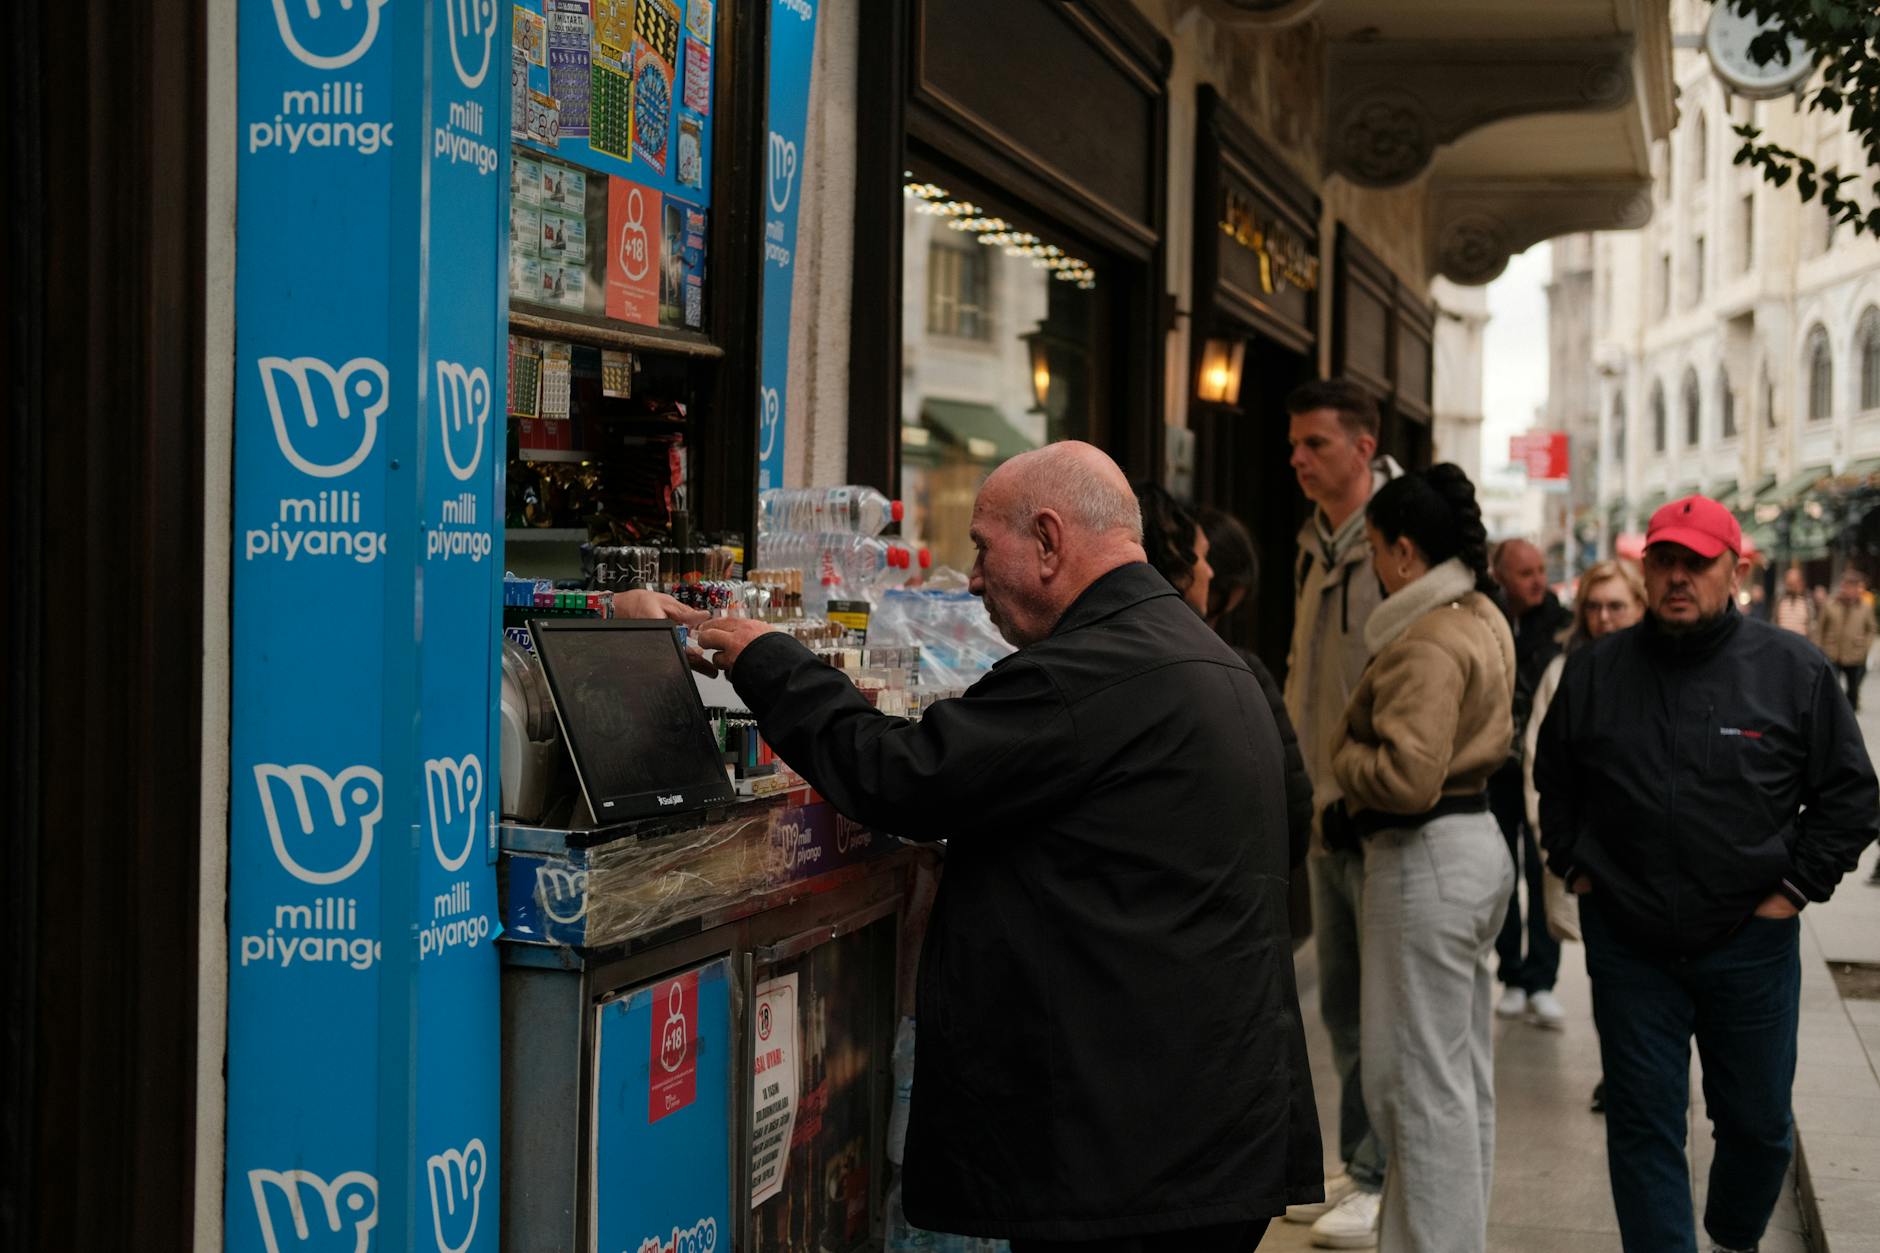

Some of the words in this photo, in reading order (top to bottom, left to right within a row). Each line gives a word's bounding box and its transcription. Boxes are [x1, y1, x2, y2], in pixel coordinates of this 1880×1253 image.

[283, 82, 363, 115] milli
[450, 101, 483, 136] milli
[435, 124, 498, 175] piyango
[625, 239, 643, 262] +18
[280, 490, 360, 523] milli
[442, 493, 476, 524] milli
[427, 523, 491, 562] piyango
[798, 828, 812, 845] milli
[797, 846, 822, 865] piyango
[275, 897, 356, 930] milli
[435, 881, 470, 919] milli
[241, 928, 381, 970] piyang
[420, 915, 489, 960] piyango
[665, 1028, 682, 1051] +18
[754, 1056, 765, 1076] SAL
